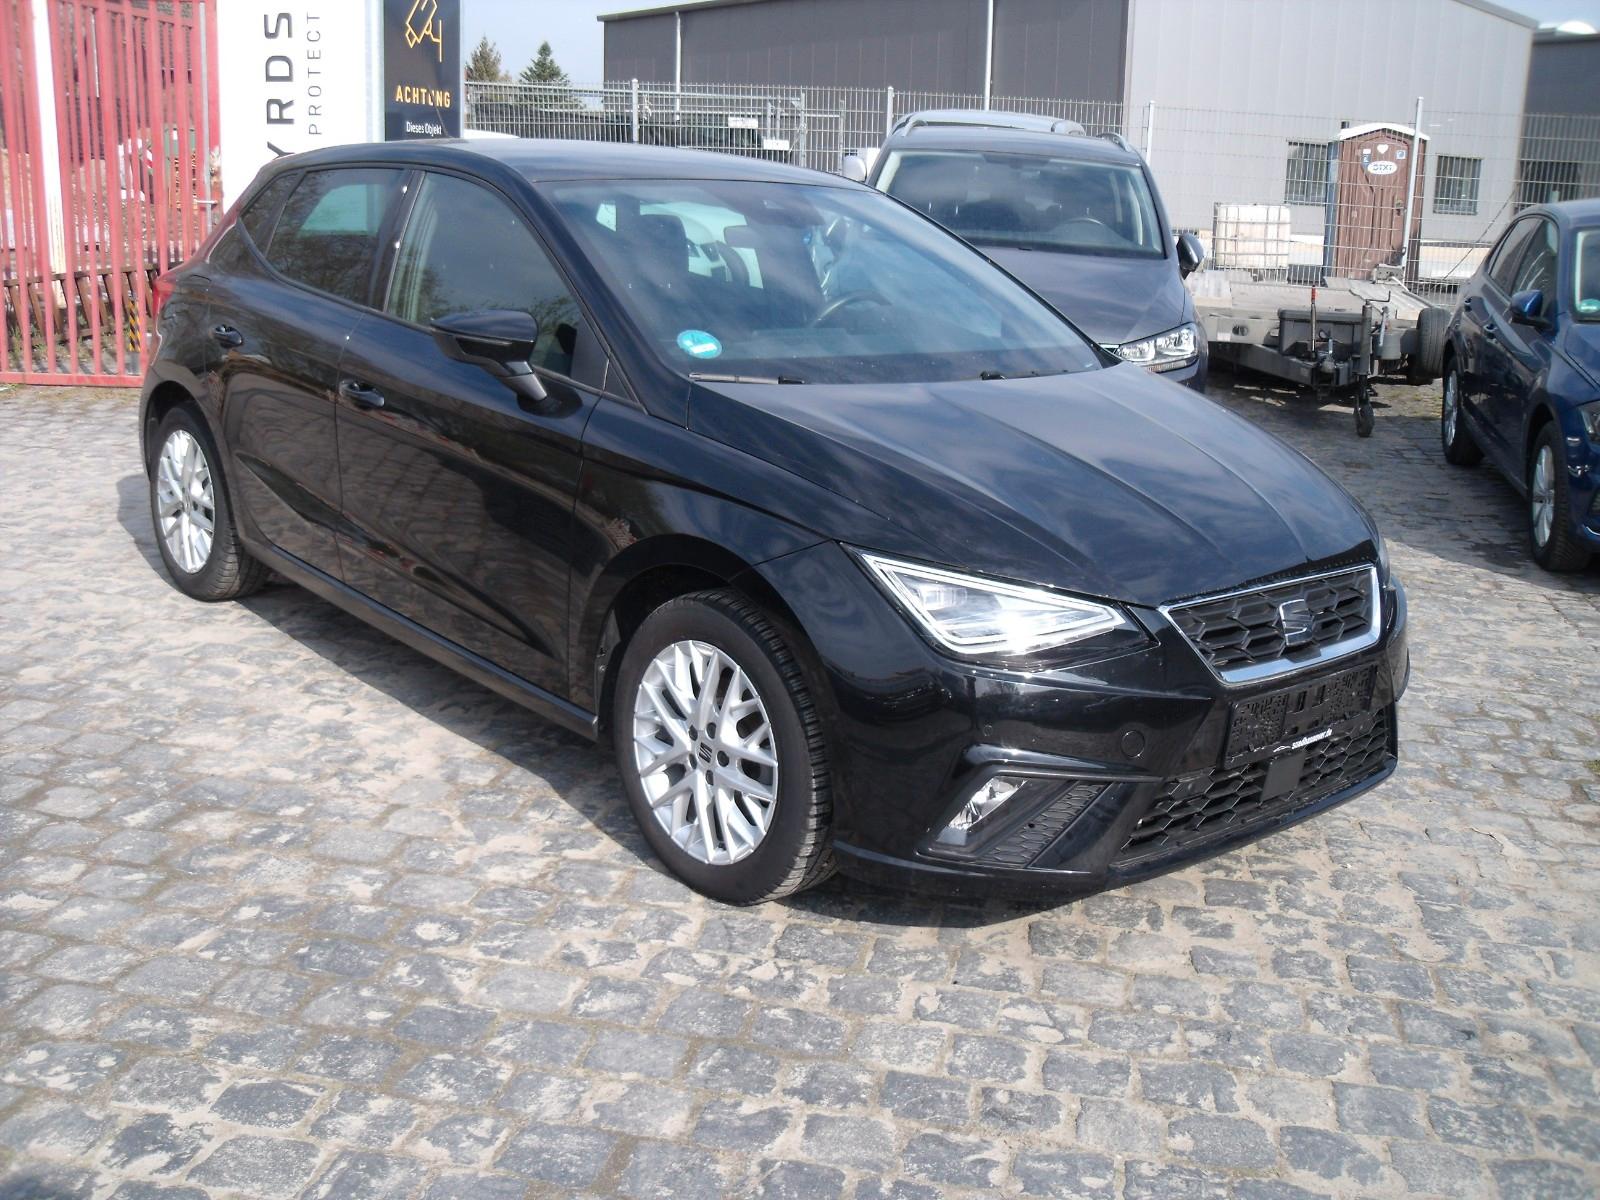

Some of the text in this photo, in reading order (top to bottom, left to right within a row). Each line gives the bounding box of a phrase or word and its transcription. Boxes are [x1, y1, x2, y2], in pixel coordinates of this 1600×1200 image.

[306, 11, 323, 136] PROTECT
[395, 84, 451, 109] ACHTUNG
[406, 120, 442, 137] Dieses Objekt
